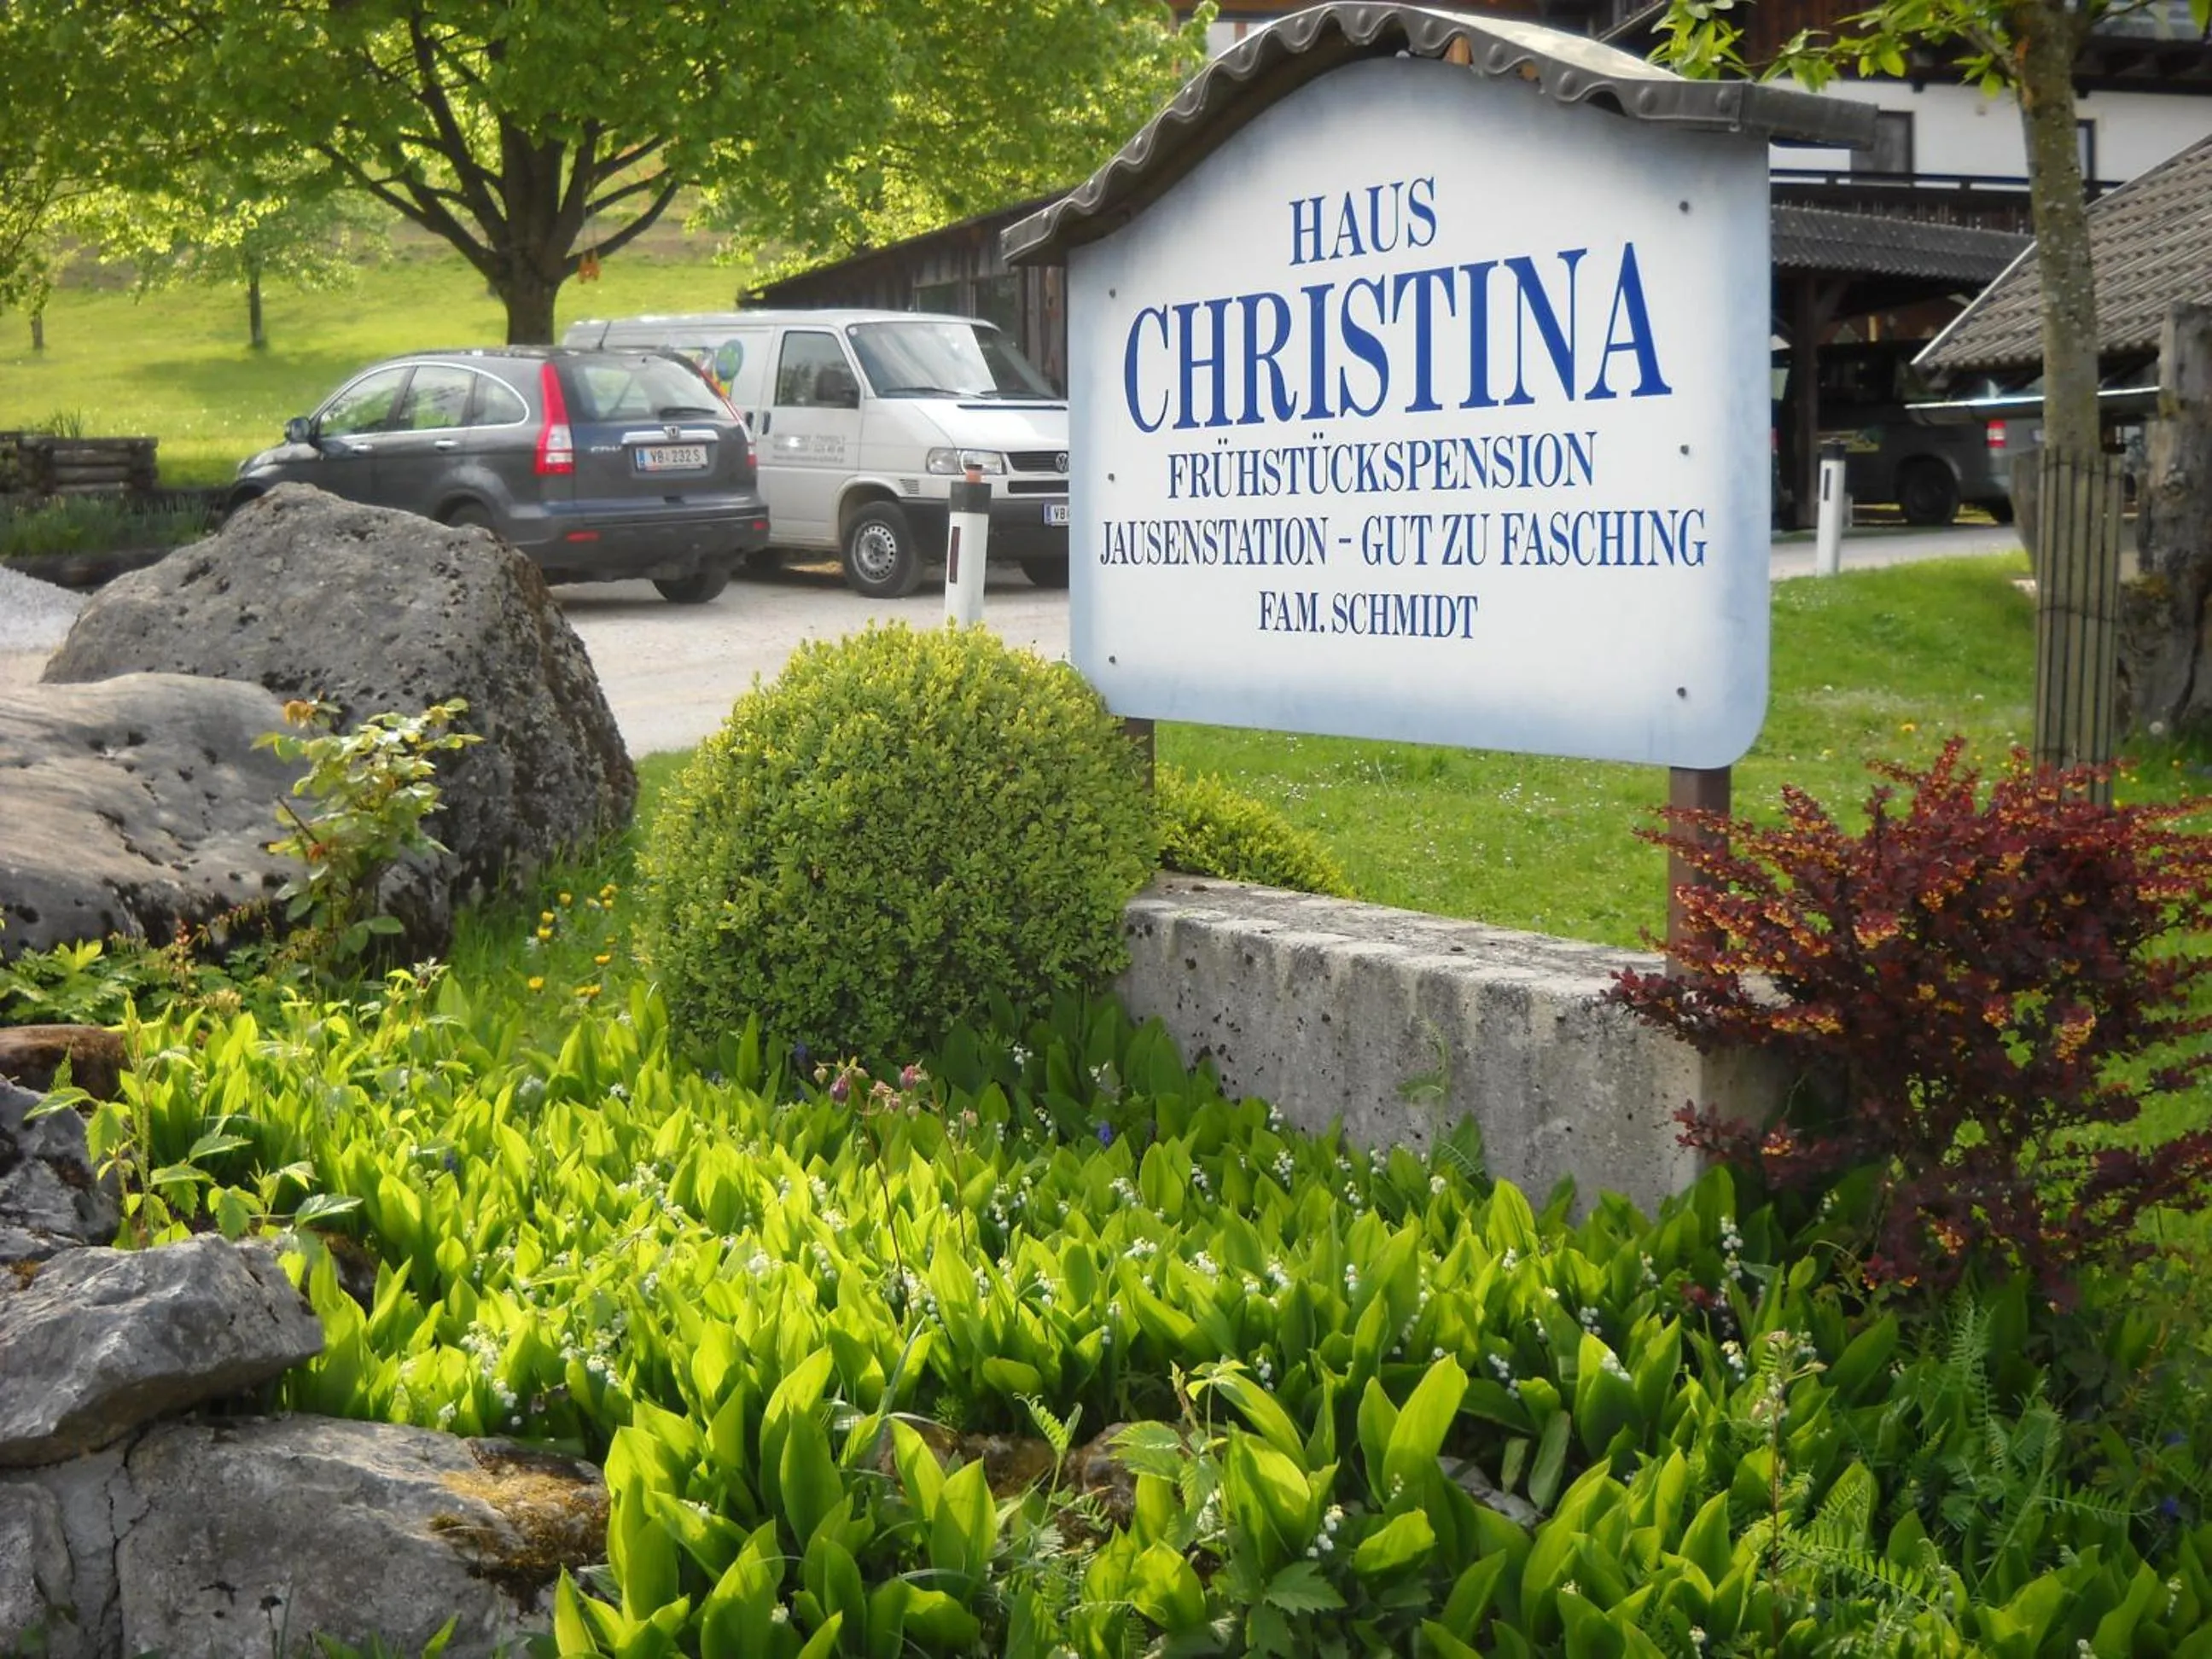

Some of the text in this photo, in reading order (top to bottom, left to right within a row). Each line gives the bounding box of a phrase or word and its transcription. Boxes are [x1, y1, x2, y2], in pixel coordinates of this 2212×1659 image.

[1289, 177, 1436, 266] HAUS
[1124, 242, 1673, 434] CHRISTINA
[1167, 432, 1598, 499] FRÜHSTÜCKSPENSION
[1099, 516, 1328, 566] JAUSENSTATION
[1363, 515, 1433, 566] GUT
[1442, 514, 1491, 566] ZU
[1500, 509, 1708, 568] FASCHING
[1260, 591, 1478, 639] FAM. SCHMIDT
